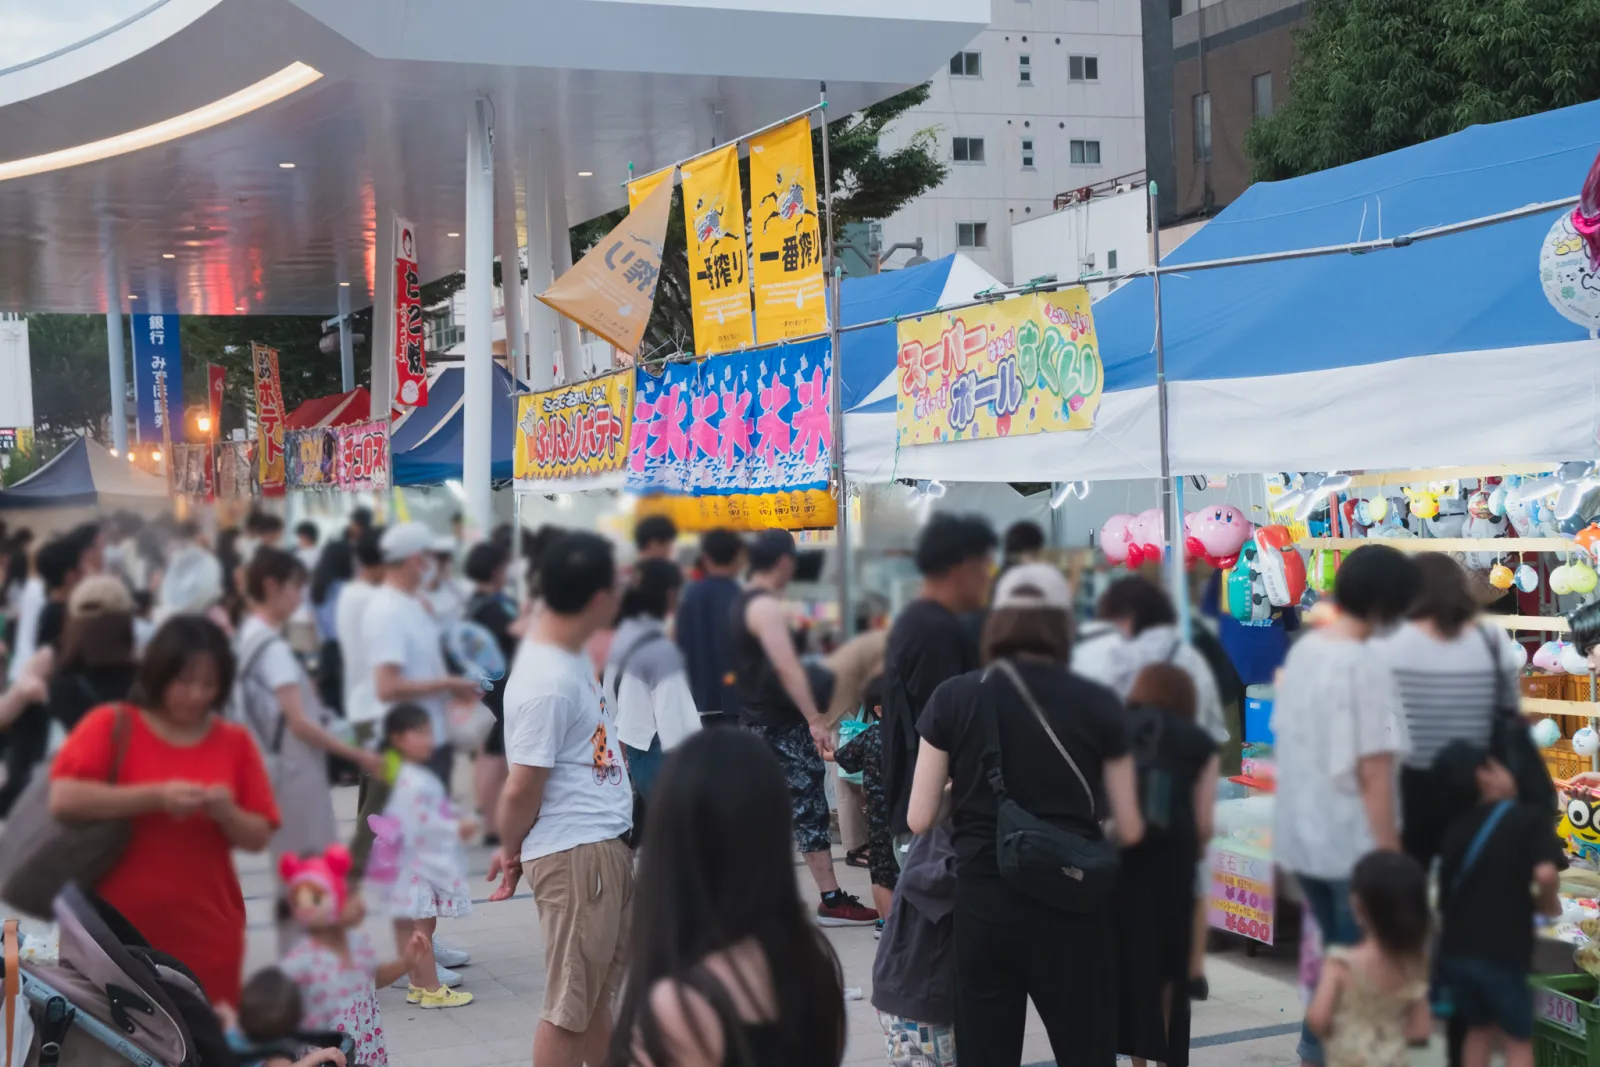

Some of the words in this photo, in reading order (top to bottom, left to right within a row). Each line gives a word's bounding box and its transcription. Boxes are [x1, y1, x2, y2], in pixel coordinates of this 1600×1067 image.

[760, 227, 820, 272] 一番搾り
[149, 315, 165, 345] 銀行
[901, 318, 988, 396] スーパー
[1017, 319, 1098, 404] すくい
[949, 353, 1024, 433] ボール
[343, 431, 385, 483] チュロス
[536, 402, 622, 469] ふりふりポテト
[1225, 911, 1270, 942] ¥600
